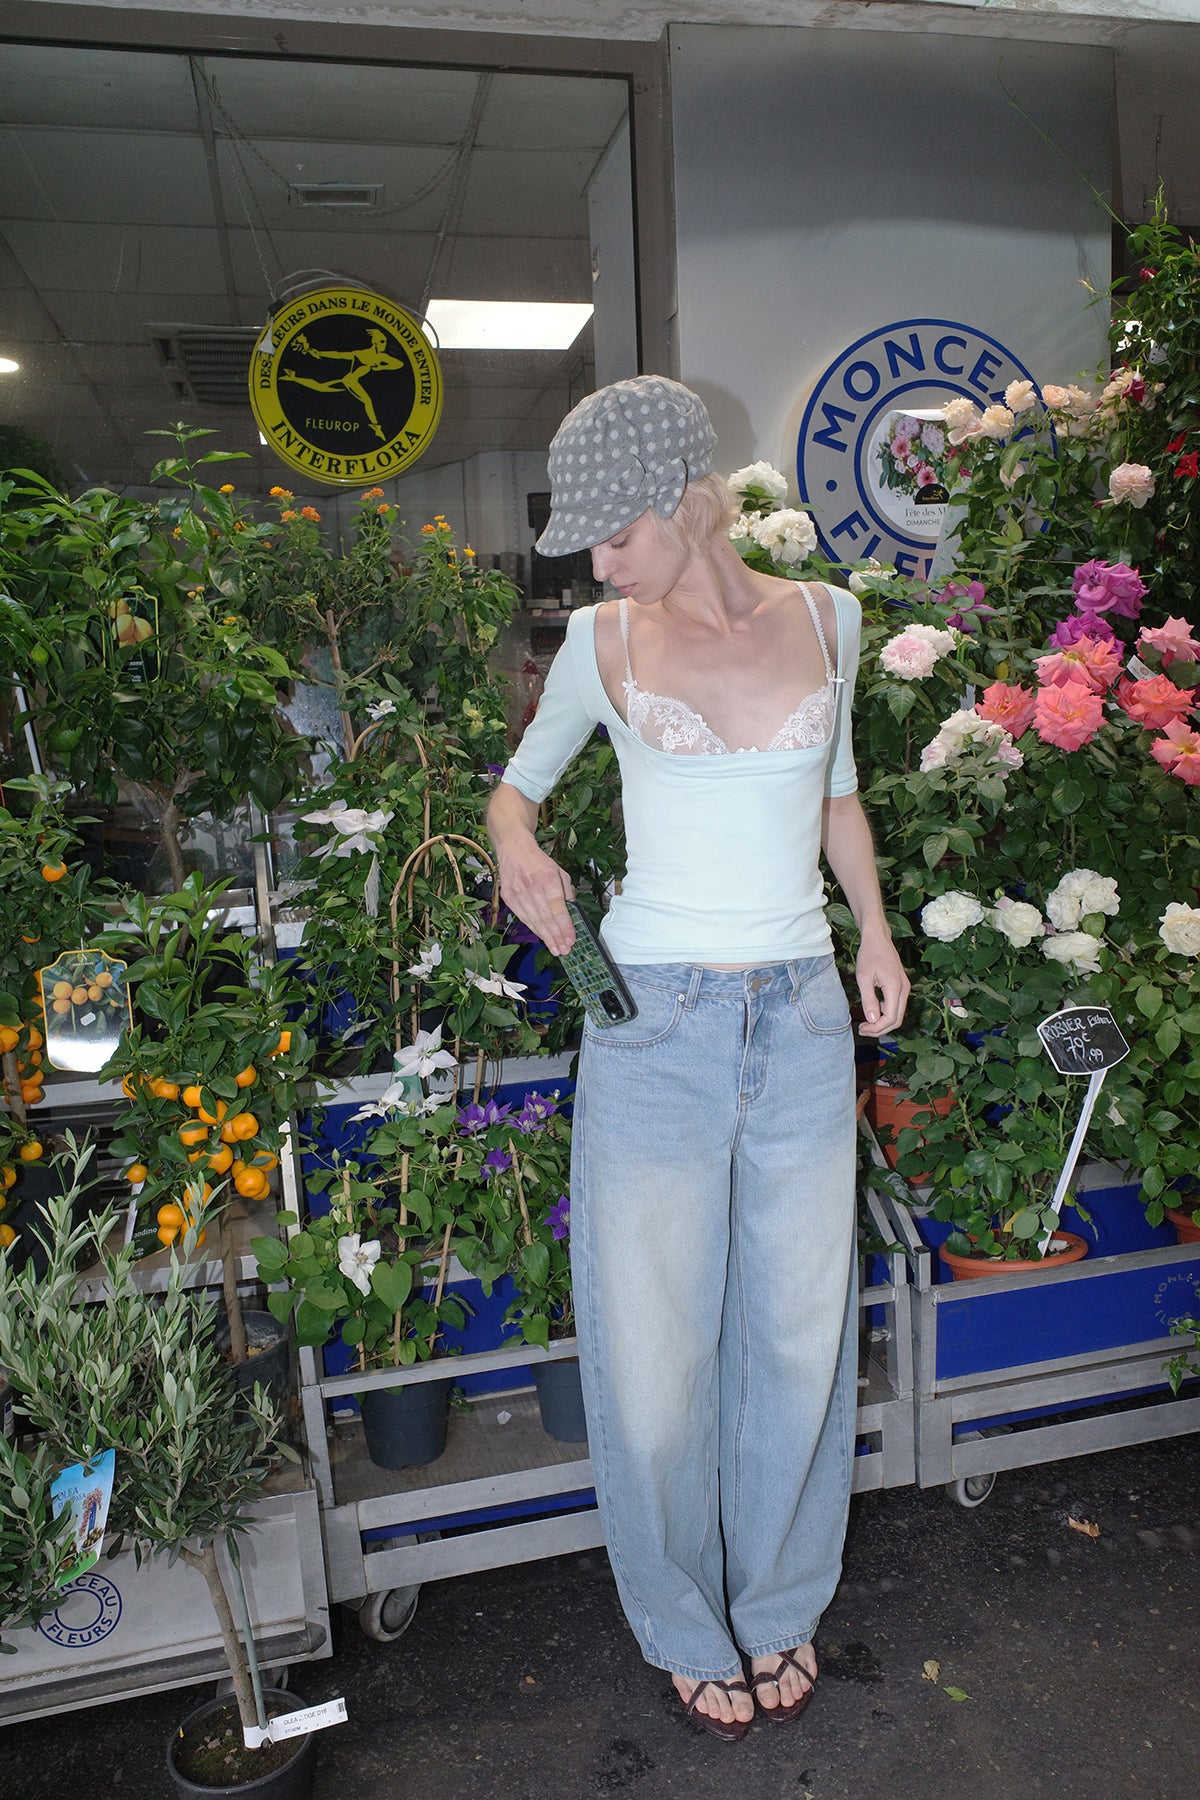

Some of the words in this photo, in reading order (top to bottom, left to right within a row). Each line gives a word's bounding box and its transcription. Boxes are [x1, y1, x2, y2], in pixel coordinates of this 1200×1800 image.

[260, 359, 273, 390] DES
[268, 308, 307, 353] LEURS
[307, 297, 348, 315] DANS
[351, 298, 371, 313] LE
[373, 305, 419, 349] MONDE
[413, 350, 433, 406] ENTIER
[305, 417, 360, 432] FLEUROP
[271, 420, 422, 475] INTERFLORA
[1040, 1017, 1086, 1042] ROSIER
[47, 1616, 113, 1644] FLEURS
[283, 1716, 299, 1726] OLEA
